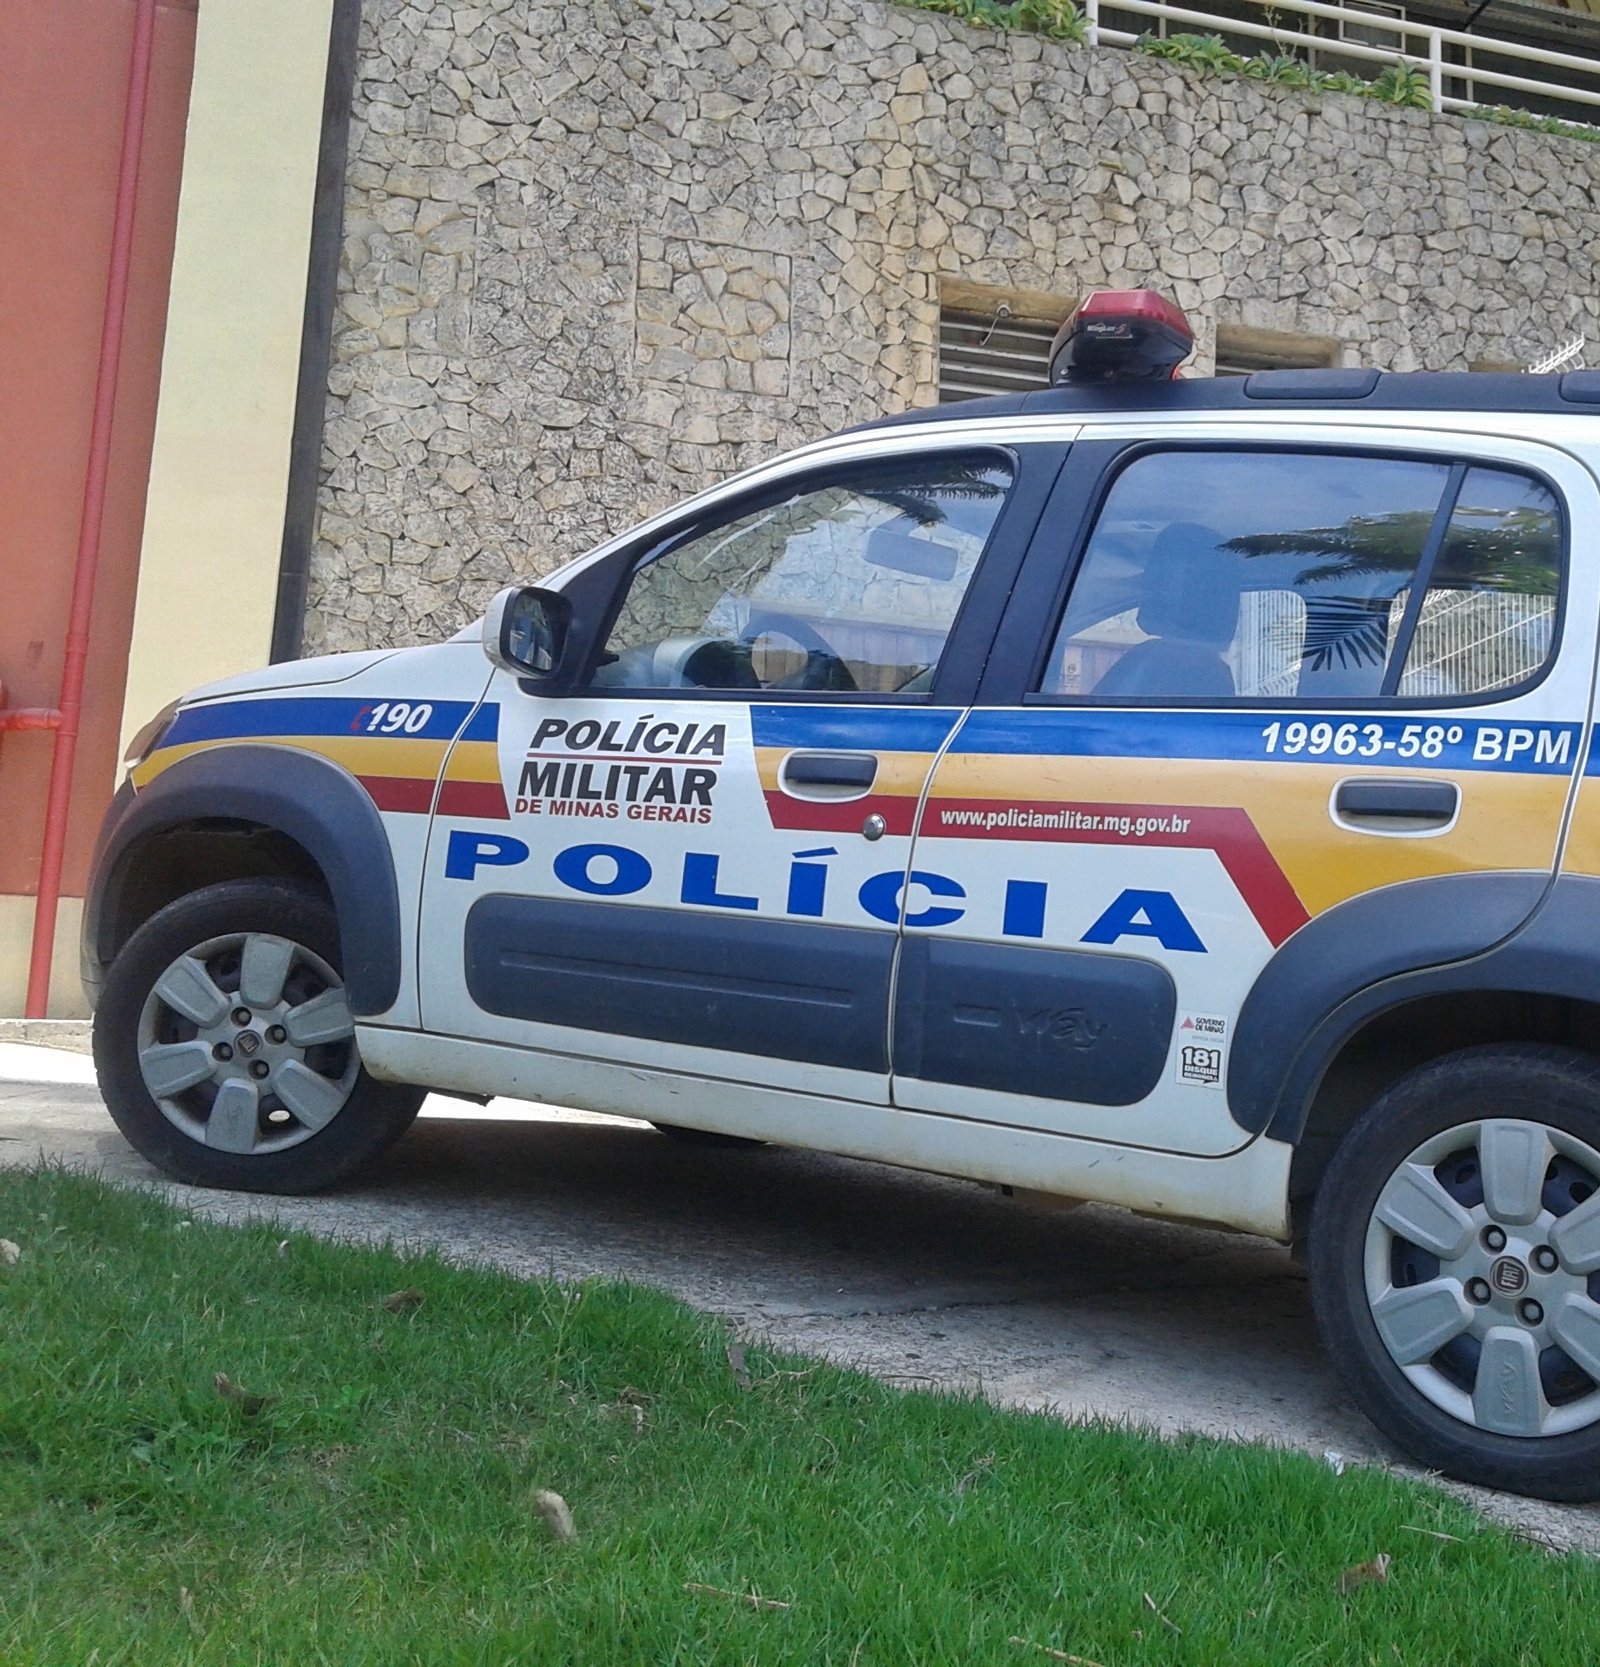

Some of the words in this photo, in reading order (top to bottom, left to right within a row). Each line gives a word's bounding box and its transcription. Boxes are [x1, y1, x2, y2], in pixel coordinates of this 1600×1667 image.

[366, 704, 433, 733] 190
[529, 714, 726, 756] POLÍCIA
[1472, 727, 1572, 764] BPM
[517, 761, 717, 806] MILITAR
[514, 799, 542, 814] DE
[548, 801, 618, 820] MINAS
[626, 806, 712, 824] GERAIS
[941, 809, 1191, 836] www.policiamilitar.mg.gov.br
[445, 830, 1209, 954] POLÍCIA
[1194, 1024, 1204, 1032] DE
[1204, 1025, 1225, 1034] MINAS
[1196, 1017, 1226, 1026] GOVERNO
[1183, 1047, 1220, 1068] 181
[1184, 1064, 1219, 1076] DISQUE
[1500, 1262, 1521, 1289] FIAT
